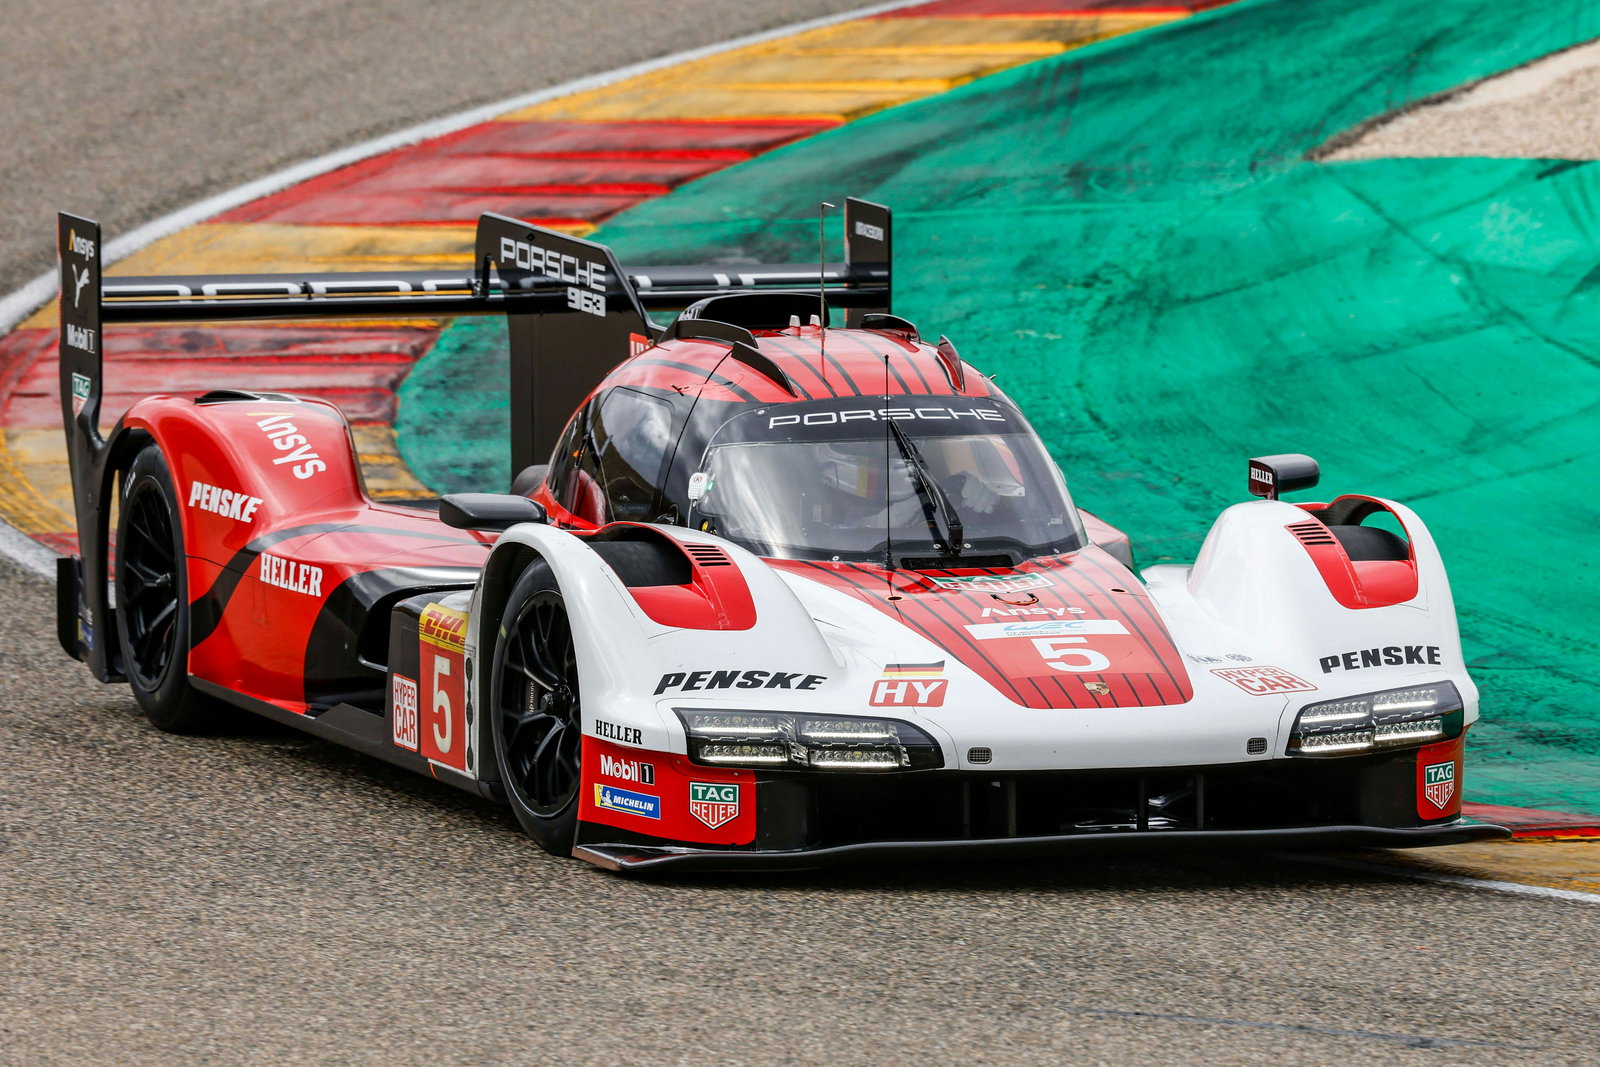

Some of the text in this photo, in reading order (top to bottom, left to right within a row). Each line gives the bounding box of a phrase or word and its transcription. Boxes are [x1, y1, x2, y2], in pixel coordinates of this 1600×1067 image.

[501, 237, 606, 292] PORSCHE
[567, 287, 606, 317] 963
[768, 407, 1006, 429] PORSCHE
[246, 411, 327, 480] Ansys
[1250, 467, 1274, 485] HELLER
[188, 481, 264, 523] PENSKE
[260, 552, 323, 597] HELLER
[980, 607, 1086, 618] Ansys
[423, 610, 465, 645] DHL
[1031, 636, 1111, 672] 5
[1319, 645, 1441, 674] PENSKE
[653, 670, 828, 696] PENSKE
[1217, 666, 1287, 680] HYPER
[1235, 675, 1310, 692] CAR
[394, 679, 416, 709] HYPER
[433, 654, 453, 754] 5
[873, 681, 943, 703] HY
[395, 704, 416, 744] CAR
[595, 719, 643, 745] HELLER
[600, 754, 639, 782] Mobil
[1428, 765, 1453, 782] TAG
[613, 795, 654, 812] MICHELIN
[693, 785, 734, 801] TAG
[1427, 782, 1453, 805] HEUER
[692, 803, 736, 826] HEUER
